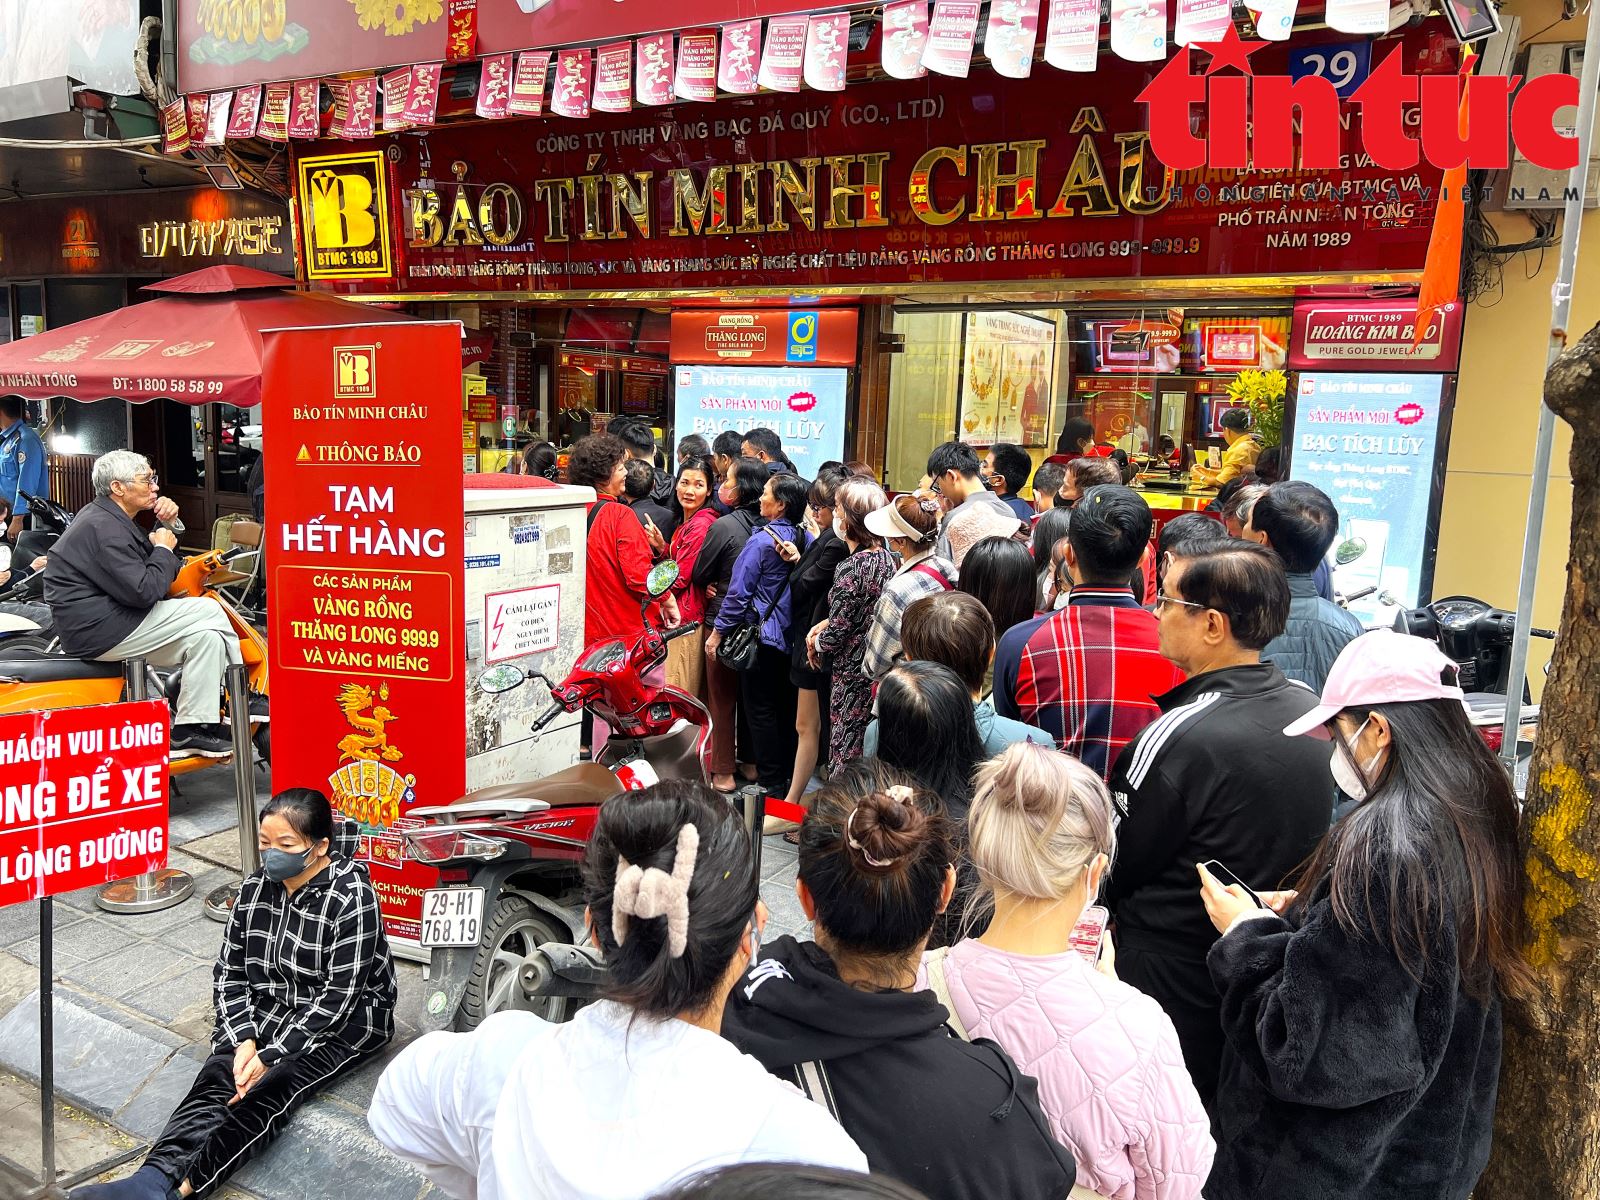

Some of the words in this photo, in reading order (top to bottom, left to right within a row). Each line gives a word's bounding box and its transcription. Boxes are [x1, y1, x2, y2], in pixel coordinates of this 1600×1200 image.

[1302, 51, 1357, 89] 29
[536, 134, 580, 154] CÔNG
[584, 132, 604, 150] TY
[610, 128, 655, 147] TNHH
[714, 117, 752, 140] BẠC
[758, 110, 784, 133] ĐÁ
[791, 104, 832, 130] QUÝ
[897, 95, 944, 120] LTD)
[406, 160, 522, 248] BẢO
[536, 153, 654, 243] TÍN
[668, 152, 890, 238] MINH
[908, 106, 1172, 226] CHÂU
[1342, 177, 1393, 196] BTMC
[1400, 173, 1422, 192] VÀ
[1218, 208, 1252, 227] PHỐ
[1256, 205, 1302, 225] TRẦN
[1362, 202, 1415, 220] TÔNG
[1266, 232, 1308, 248] NĂM
[1312, 232, 1352, 247] 1989
[318, 251, 348, 266] BTMC
[351, 250, 378, 264] 1989
[527, 258, 562, 276] THĂNG
[565, 262, 597, 276] LONG,
[622, 257, 636, 274] VÀ
[640, 256, 670, 273] VÀNG
[672, 259, 712, 272] TRANG
[714, 254, 738, 270] SỨC
[740, 253, 760, 270] MỸ
[762, 252, 798, 272] NGHỆ
[800, 248, 834, 268] CHẤT
[837, 249, 866, 270] LIỆU
[870, 244, 908, 266] BẰNG
[912, 244, 952, 264] VÀNG
[954, 242, 996, 263] RỒNG
[1001, 240, 1056, 261] THĂNG
[1060, 240, 1104, 258] LONG
[1347, 314, 1376, 322] BTMC
[1378, 314, 1402, 322] 1989
[706, 330, 738, 342] THĂNG
[740, 332, 764, 342] LONG
[1310, 322, 1364, 340] HOÀNG
[1366, 325, 1398, 340] KIM
[1401, 325, 1437, 340] BO
[790, 344, 814, 358] SJC
[1320, 346, 1344, 355] PURE
[1347, 346, 1375, 355] GOLD
[7, 371, 42, 388] NHÂN
[112, 376, 134, 390] ĐT:
[136, 378, 168, 392] 1800
[170, 378, 186, 392] 58
[188, 380, 205, 394] 58
[207, 381, 224, 394] 99
[293, 404, 320, 420] BẢO
[323, 404, 346, 420] TÍN
[348, 406, 385, 420] MINH
[388, 402, 428, 420] CHÂU
[693, 416, 732, 438] BẠC
[736, 416, 780, 436] TÍCH
[786, 416, 825, 440] LŨY
[316, 440, 379, 462] THÔNG
[384, 441, 422, 462] BÁO
[1302, 433, 1339, 456] BẠC
[1342, 432, 1384, 455] TÍCH
[1388, 432, 1424, 456] LŨY
[328, 486, 394, 520] TẠM
[282, 514, 342, 552] HẾT
[350, 520, 446, 558] HÀNG
[314, 572, 339, 588] CÁC
[342, 574, 368, 590] SẢN
[372, 574, 412, 592] PHẨM
[313, 594, 360, 617] VÀNG
[364, 594, 413, 620] RỒNG
[291, 618, 346, 642] THĂNG
[351, 626, 396, 645] LONG
[401, 628, 440, 648] 999.9
[303, 646, 324, 664] VÀ
[327, 648, 372, 668] VÀNG
[377, 651, 430, 672] MIẾNG
[68, 730, 103, 756] VUI
[110, 720, 164, 750] LÒNG
[0, 781, 56, 825] NG
[67, 756, 113, 814] ĐỂ
[121, 764, 162, 804] XE
[0, 845, 72, 885] LÒNG
[79, 826, 163, 869] ĐƯỜNG
[390, 895, 408, 906] NÀY
[392, 884, 424, 897] THÔNG
[430, 892, 474, 916] 29-H1
[424, 919, 477, 943] 768.19
